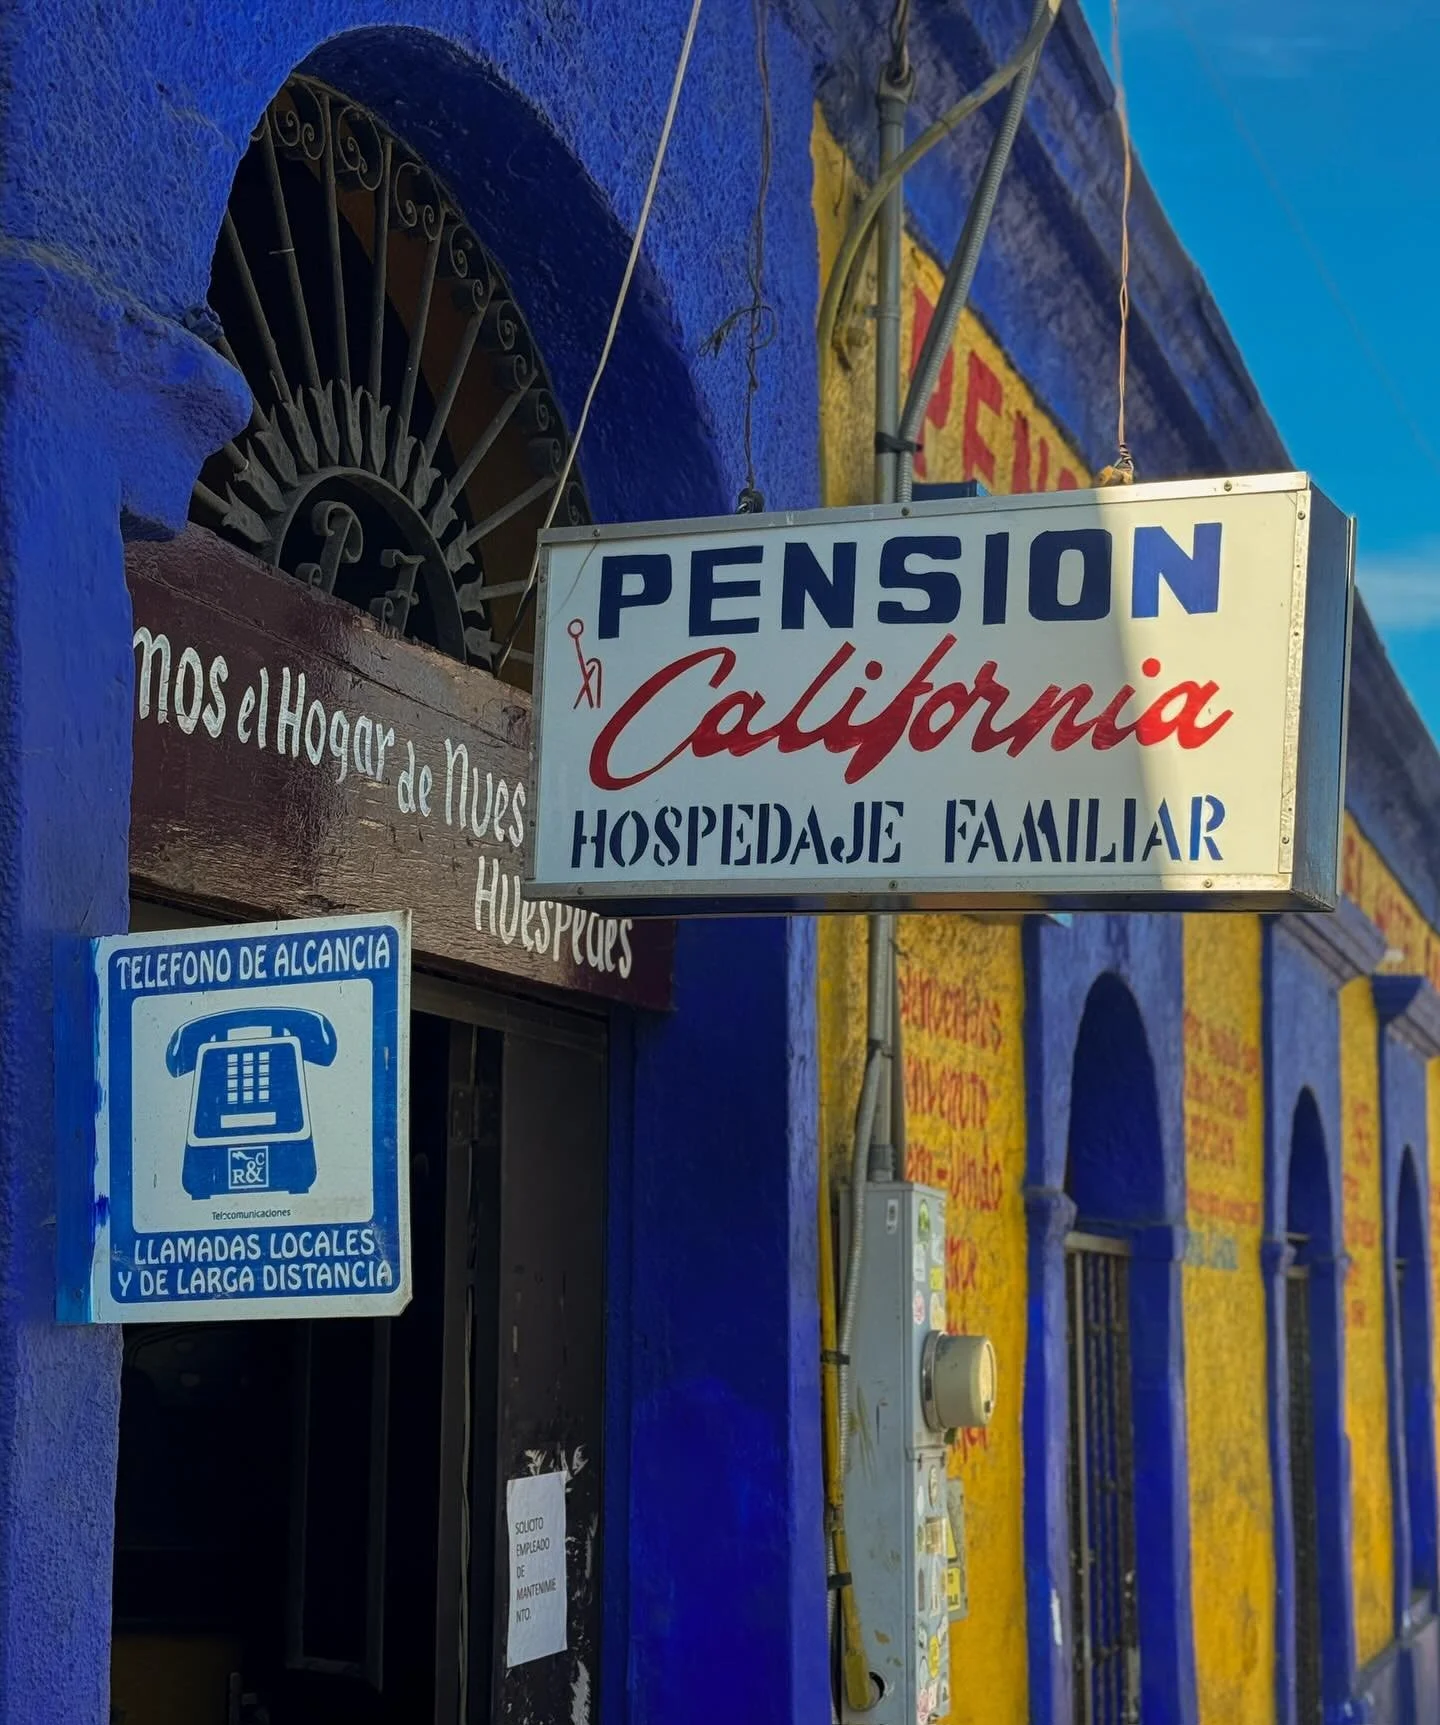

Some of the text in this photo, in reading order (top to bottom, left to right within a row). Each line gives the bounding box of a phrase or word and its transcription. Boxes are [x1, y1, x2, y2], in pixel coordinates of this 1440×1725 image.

[599, 523, 1223, 639] PENSION
[589, 633, 1233, 790] California
[238, 667, 269, 749] el
[277, 666, 395, 783] Hogar
[397, 740, 432, 817] de
[571, 795, 1226, 868] HOSPEDAJE FAMILIAR
[116, 933, 390, 990] TELEFONO DE ALCANCIA
[134, 1229, 375, 1265] LLAMADAS LOCALES
[117, 1260, 393, 1297] Y DE LARGA DISTANCIA
[515, 1517, 544, 1535] SOLICITO
[516, 1537, 550, 1557] EMPLEADO
[516, 1565, 525, 1578] DE
